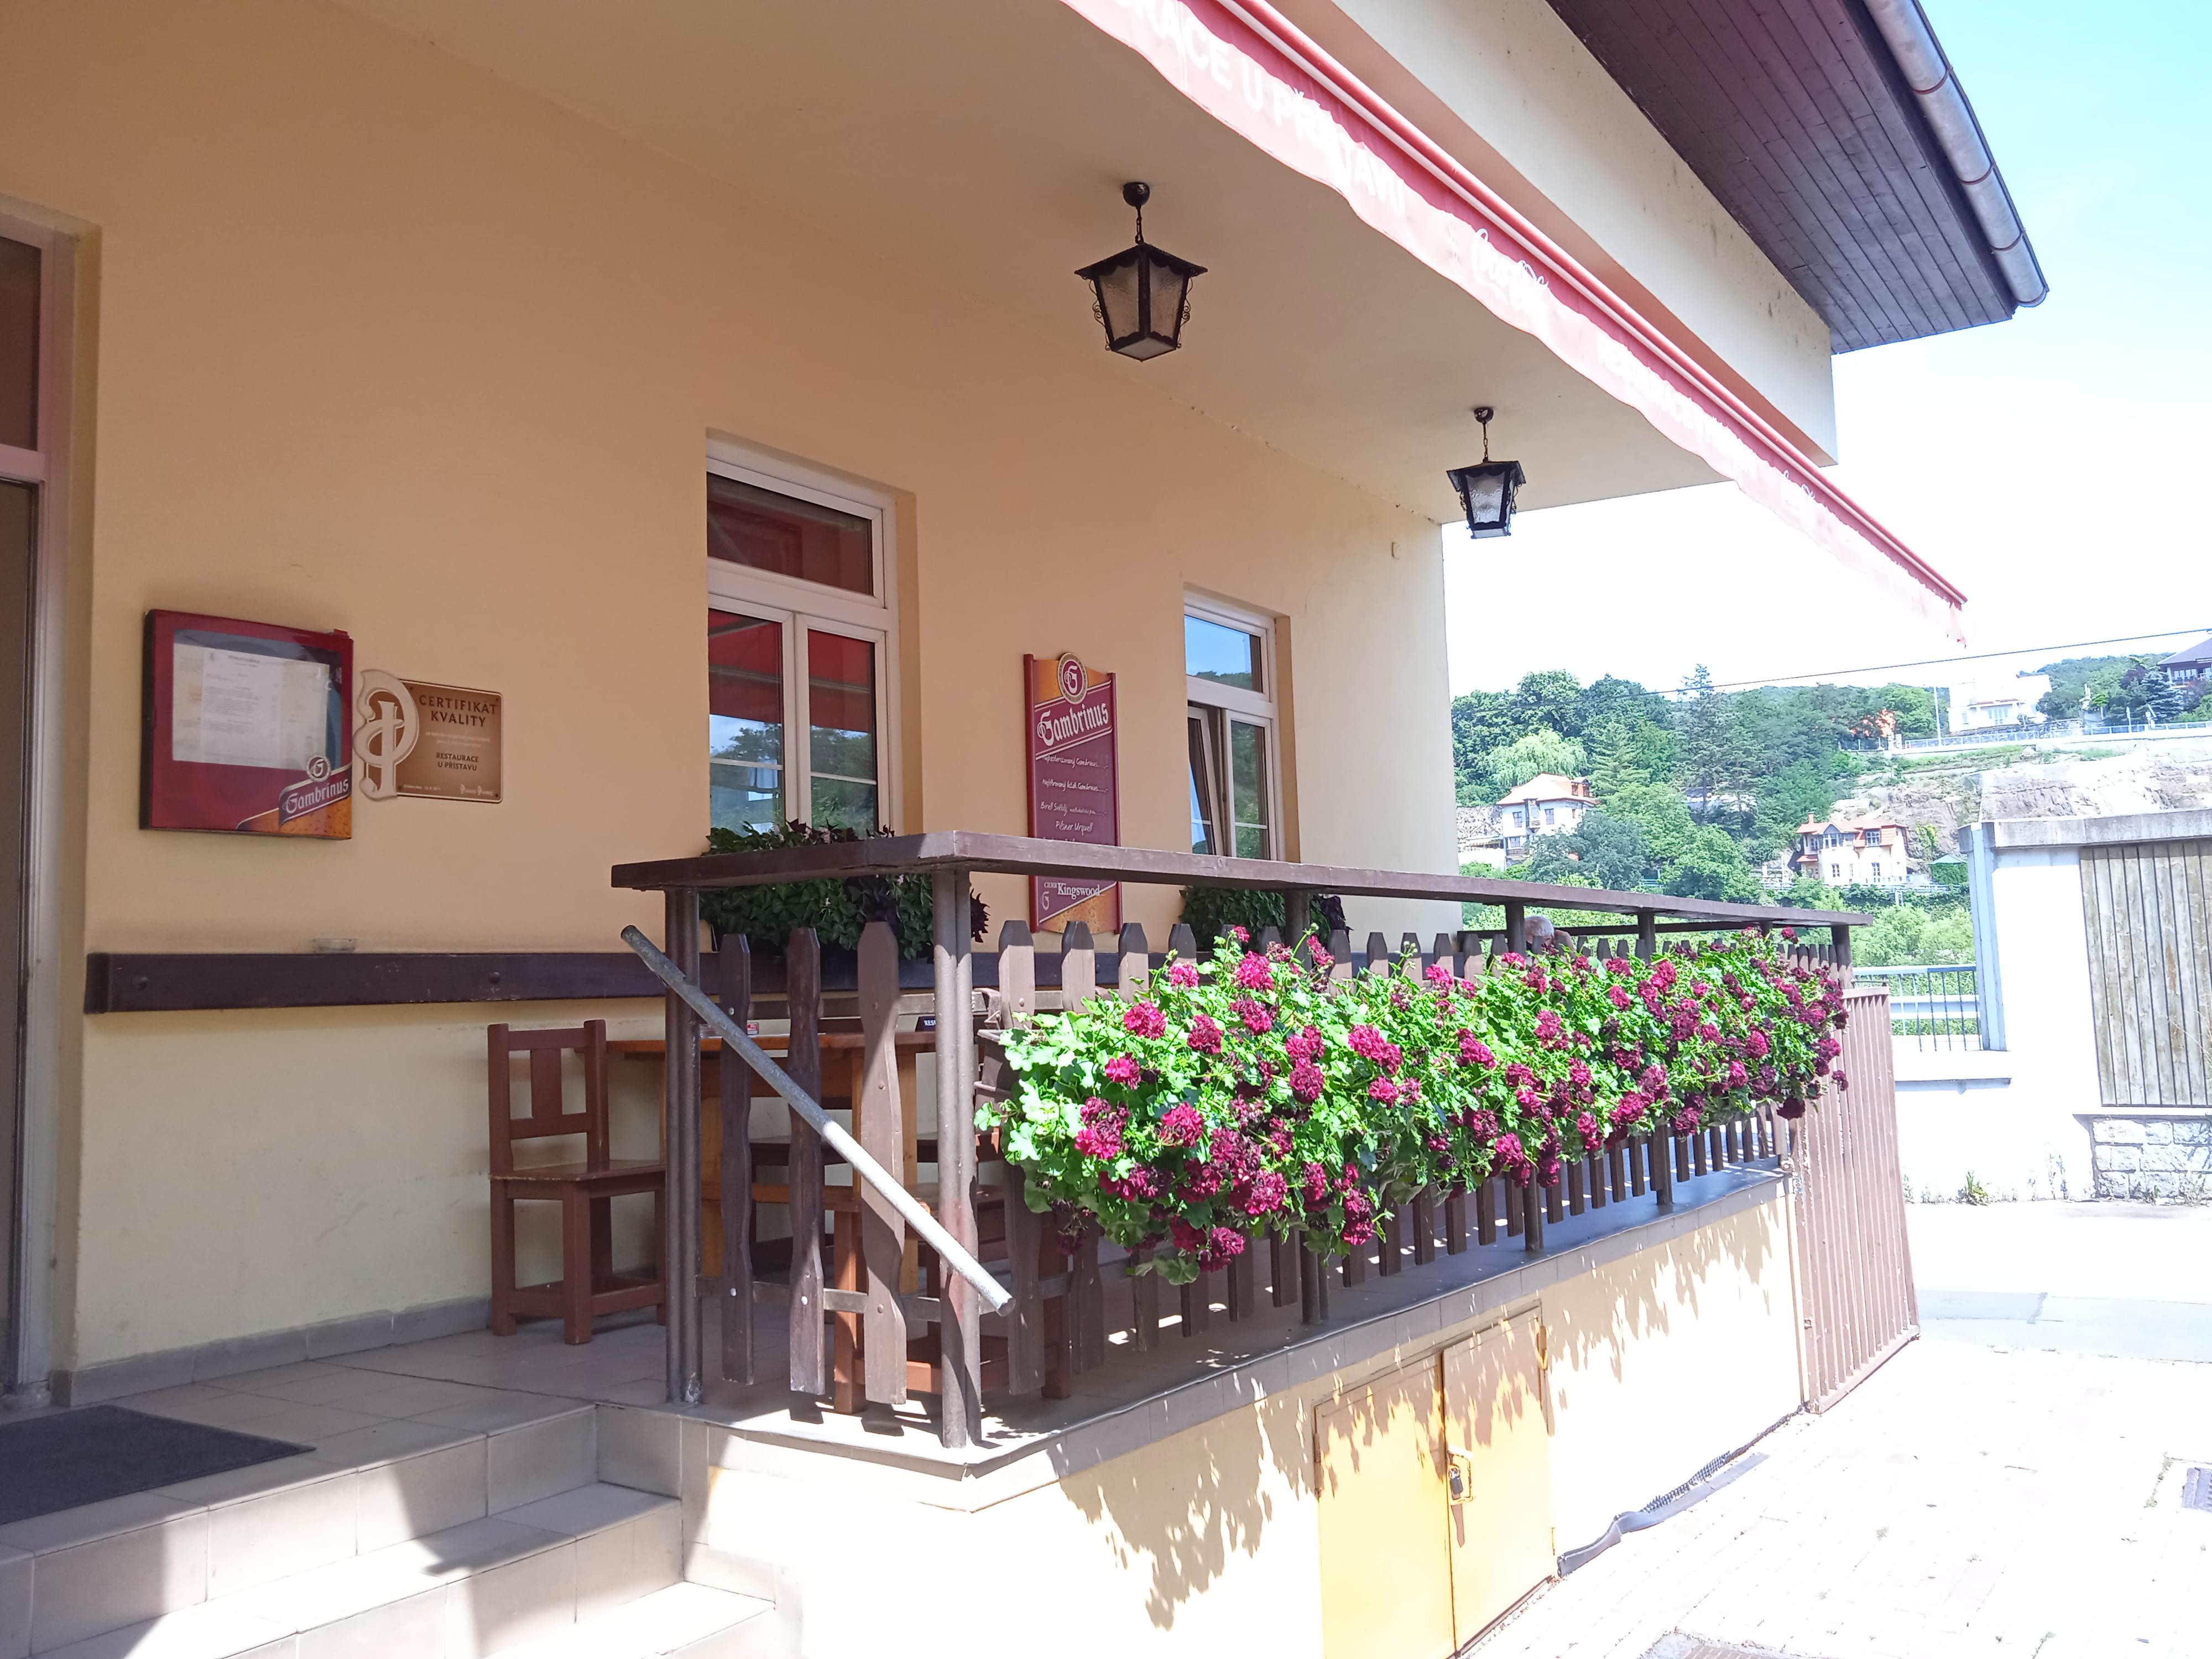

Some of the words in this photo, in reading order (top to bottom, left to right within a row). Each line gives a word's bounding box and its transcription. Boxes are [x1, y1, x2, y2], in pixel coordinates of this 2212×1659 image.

[1240, 57, 1264, 112] U
[431, 711, 486, 727] KVALITY
[1037, 703, 1109, 747] Gambrinus
[436, 752, 479, 763] RESTAURACE
[282, 778, 349, 814] Gambrinus
[1057, 883, 1100, 900] Kingswood
